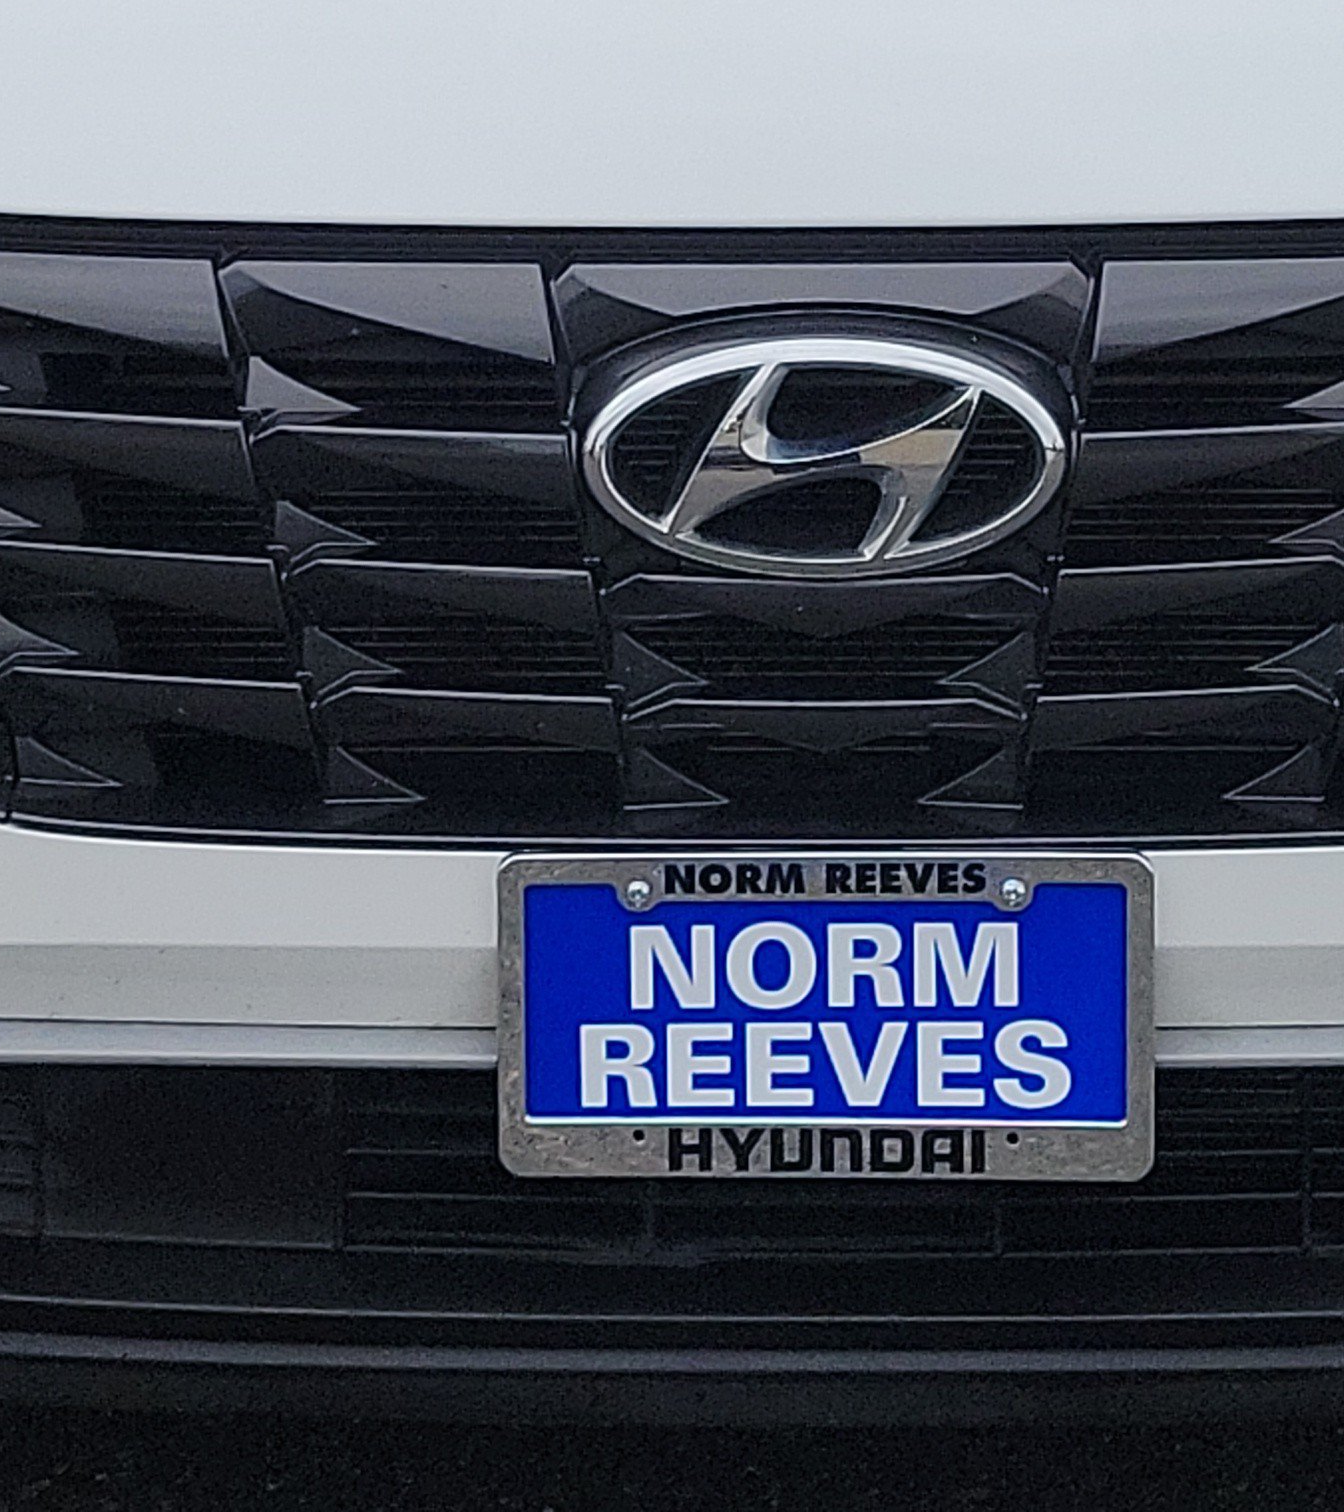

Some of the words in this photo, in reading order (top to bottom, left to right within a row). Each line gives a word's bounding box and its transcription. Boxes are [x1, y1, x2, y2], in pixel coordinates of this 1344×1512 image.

[664, 864, 806, 895] NORM
[825, 863, 987, 895] REEVES
[628, 922, 1020, 1011] NORM
[578, 1019, 1073, 1109] REEVES
[667, 1129, 987, 1175] HYUNDAI
